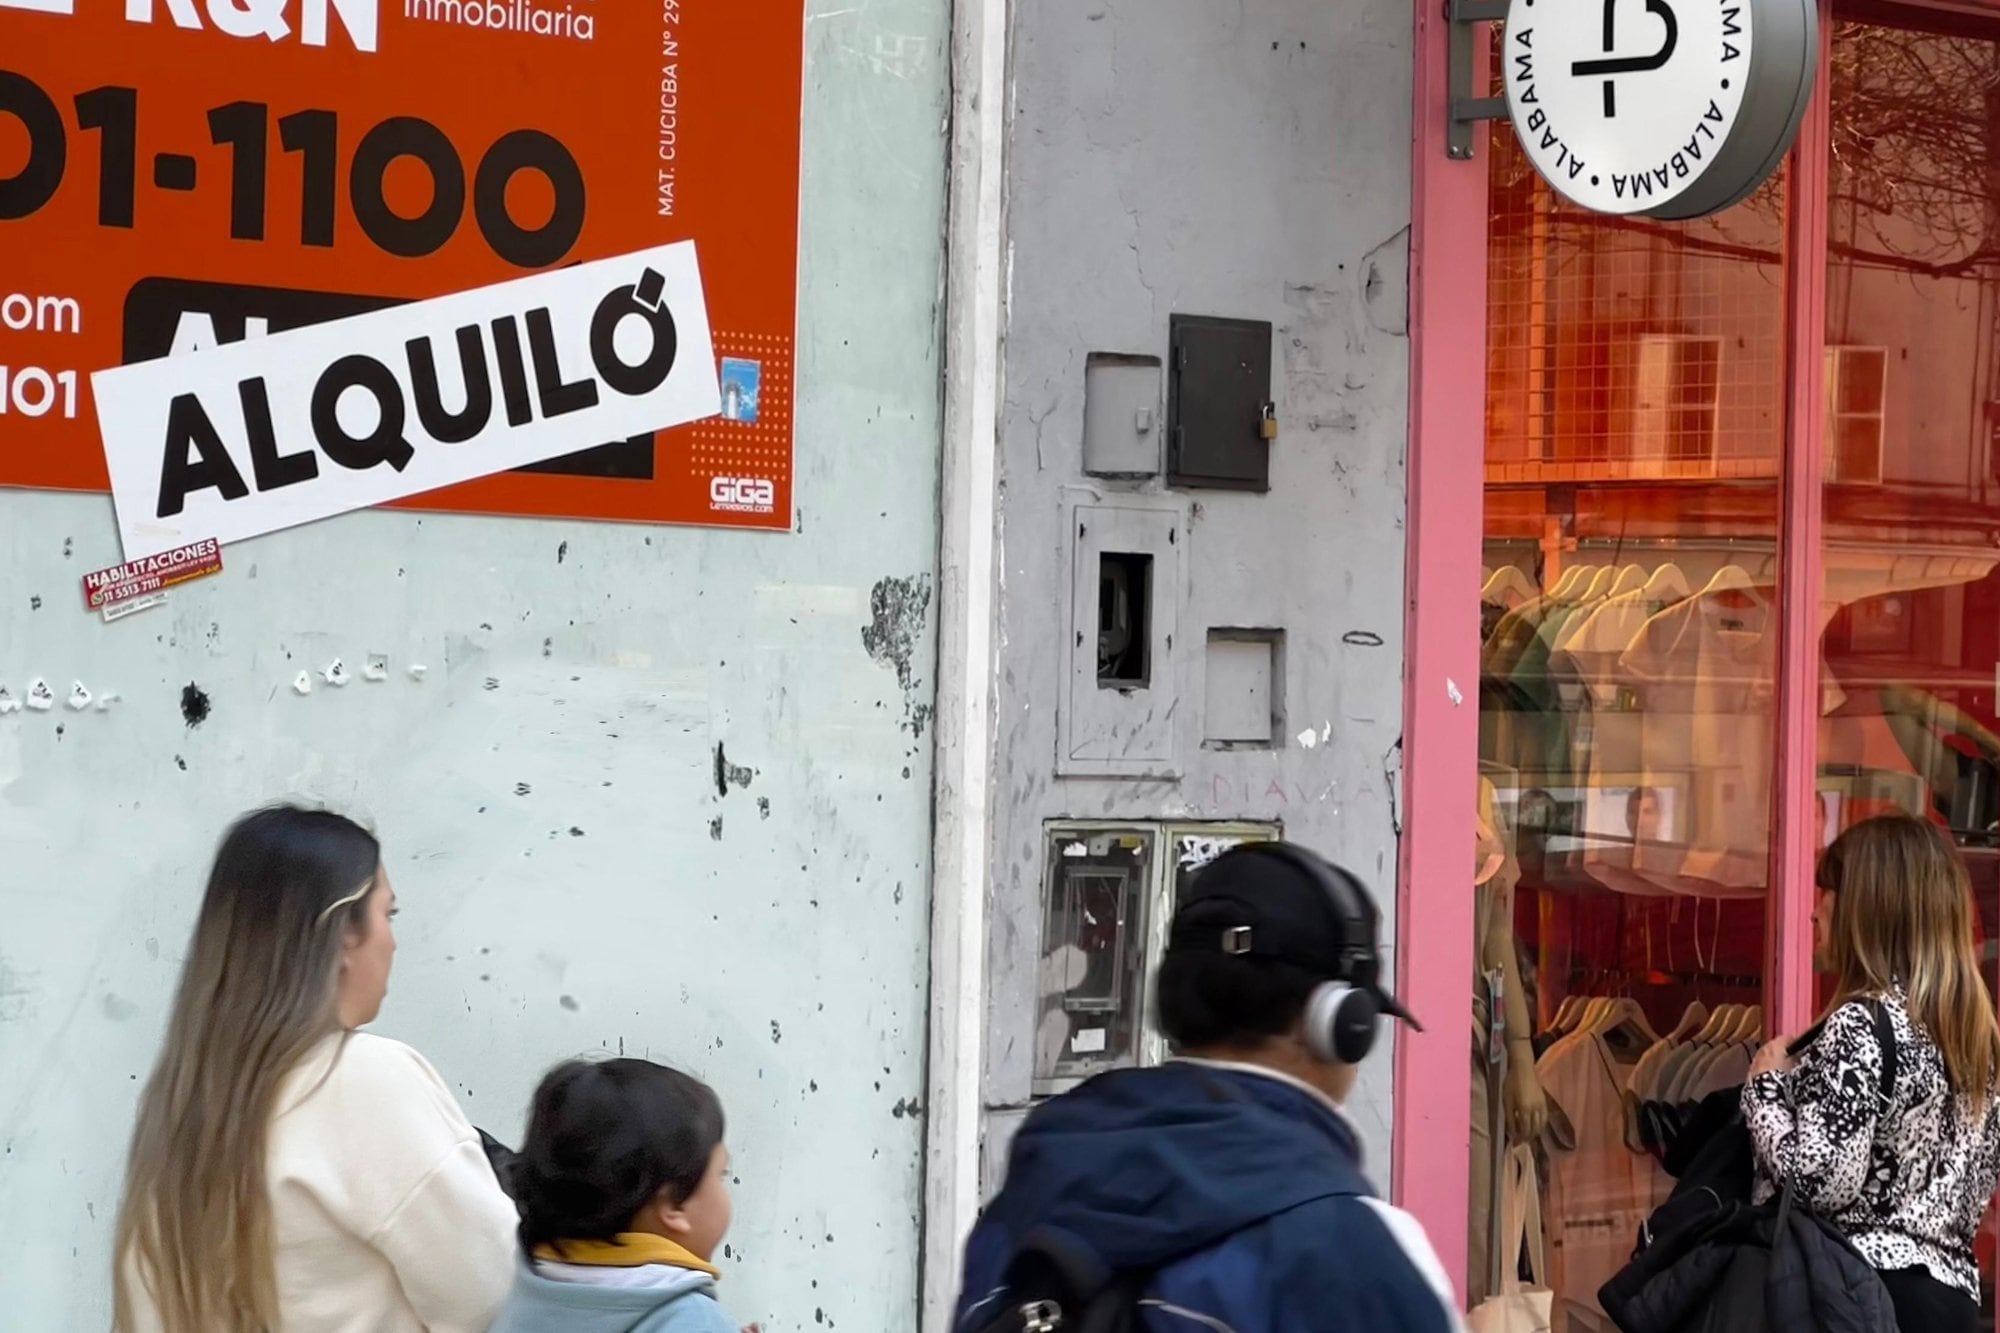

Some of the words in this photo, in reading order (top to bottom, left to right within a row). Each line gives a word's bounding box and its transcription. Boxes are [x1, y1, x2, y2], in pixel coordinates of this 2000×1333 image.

[659, 63, 678, 161] CUCICBA
[1515, 27, 1585, 180] ALABAMA
[1611, 99, 1725, 199] ALABAMA
[658, 167, 675, 217] MAT.
[156, 266, 677, 519] ALQUILÓ
[87, 540, 217, 589] HABILITACIONES
[115, 582, 140, 600] 5513
[142, 576, 161, 593] 7111
